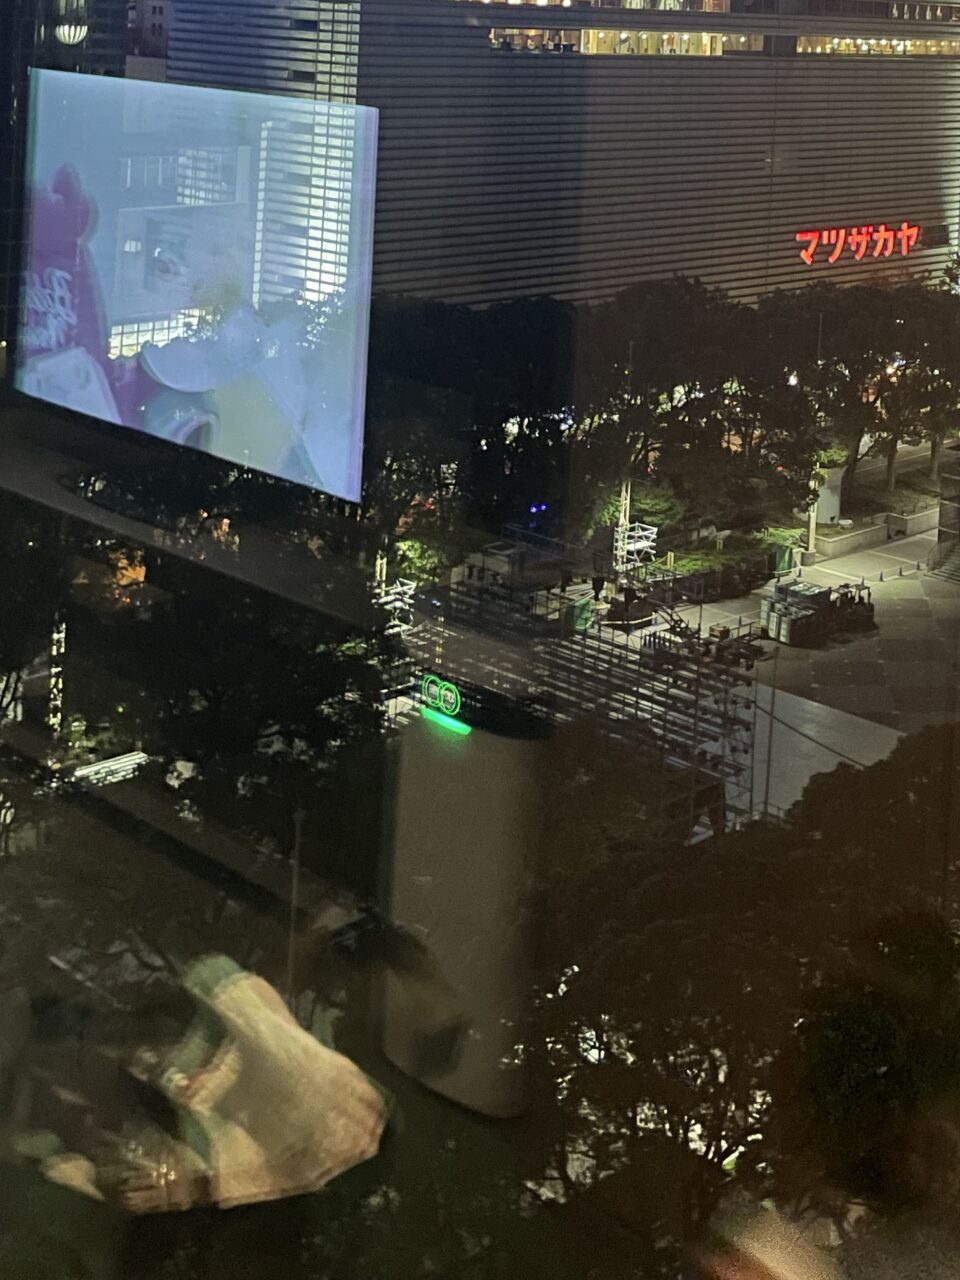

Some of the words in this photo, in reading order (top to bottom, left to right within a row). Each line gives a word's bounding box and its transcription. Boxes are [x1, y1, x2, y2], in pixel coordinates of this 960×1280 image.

[796, 221, 919, 264] マツザカヤ
